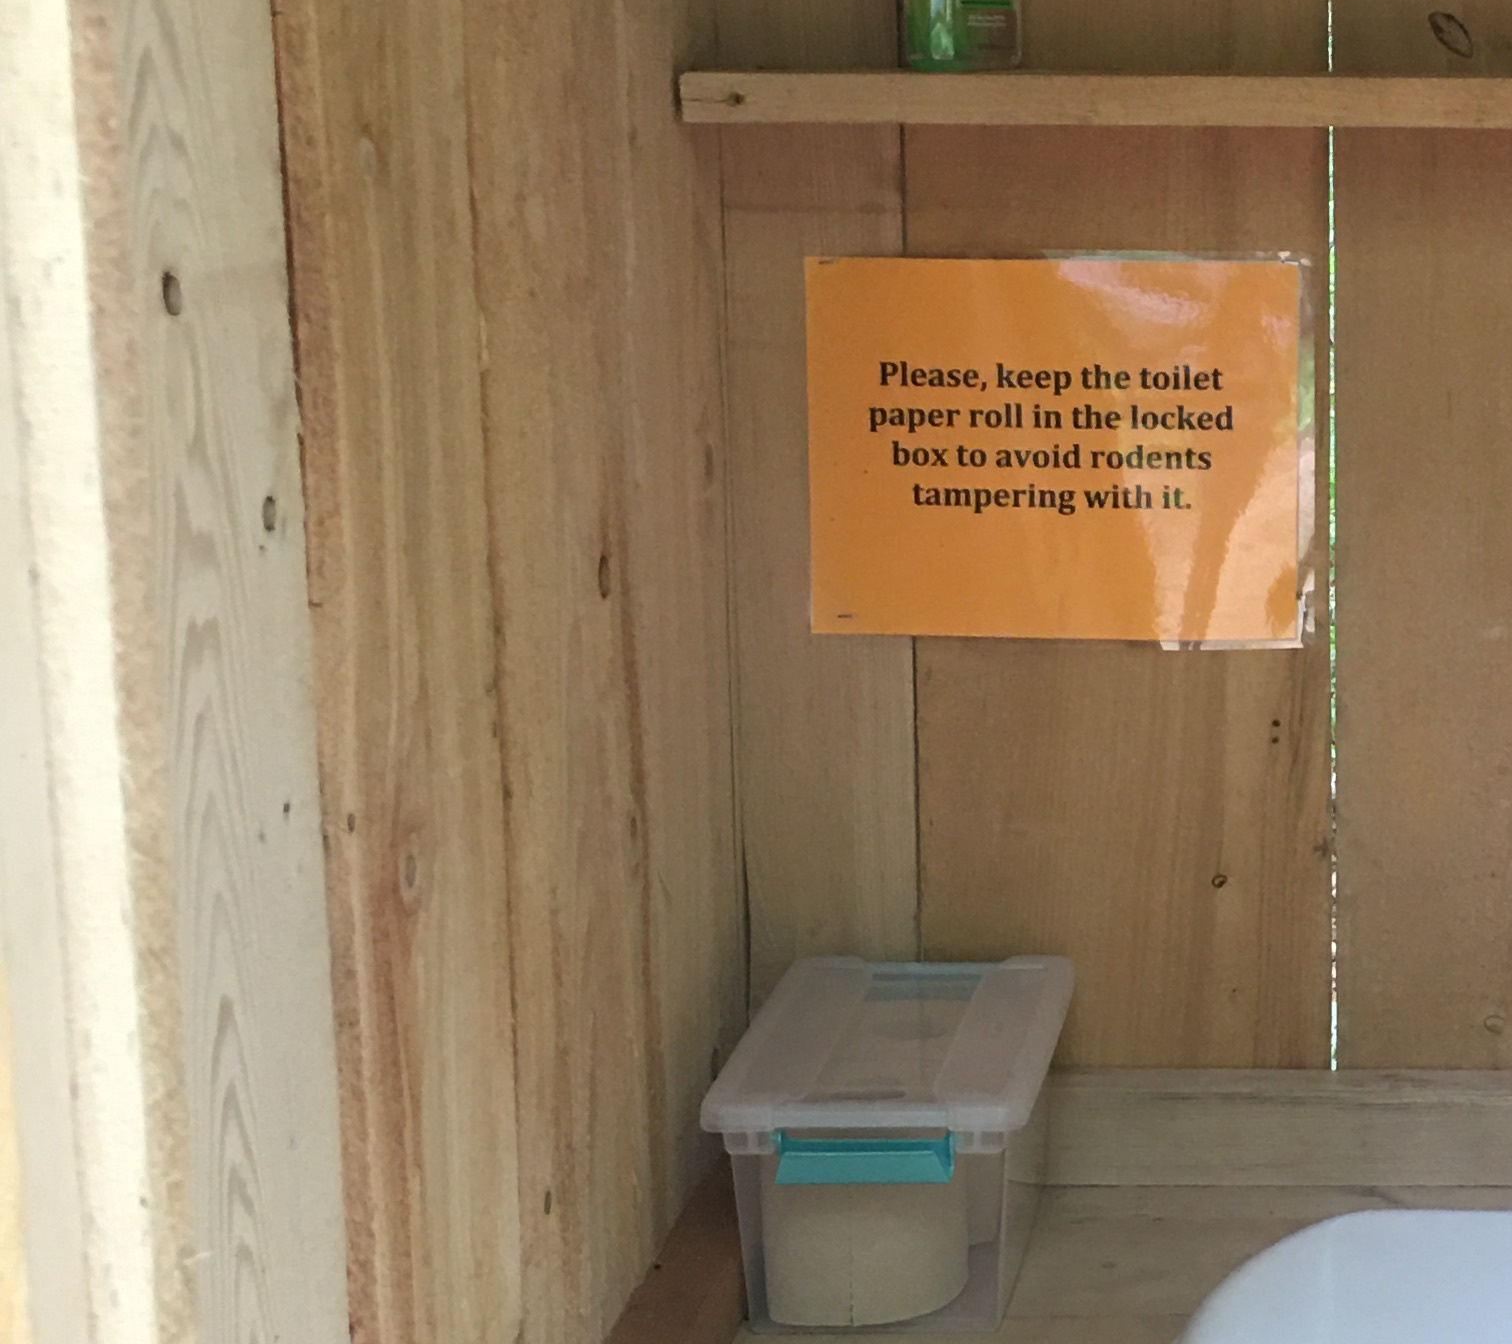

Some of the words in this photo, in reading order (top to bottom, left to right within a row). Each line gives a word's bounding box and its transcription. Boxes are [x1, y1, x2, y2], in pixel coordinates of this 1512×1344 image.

[879, 361, 987, 391] Please,
[996, 363, 1071, 395] keep
[1081, 364, 1130, 390] the
[1139, 366, 1223, 390] toilet
[869, 406, 960, 433] paper
[968, 404, 1023, 428] roll
[1033, 405, 1061, 429] in
[1071, 405, 1120, 430] the
[1130, 406, 1233, 431] locked
[892, 441, 947, 466] box
[957, 446, 987, 467] to
[995, 444, 1081, 469] avoid
[1091, 445, 1212, 470] rodents
[913, 483, 1075, 515] tampering
[1084, 484, 1152, 509] with
[1162, 485, 1191, 510] it.
